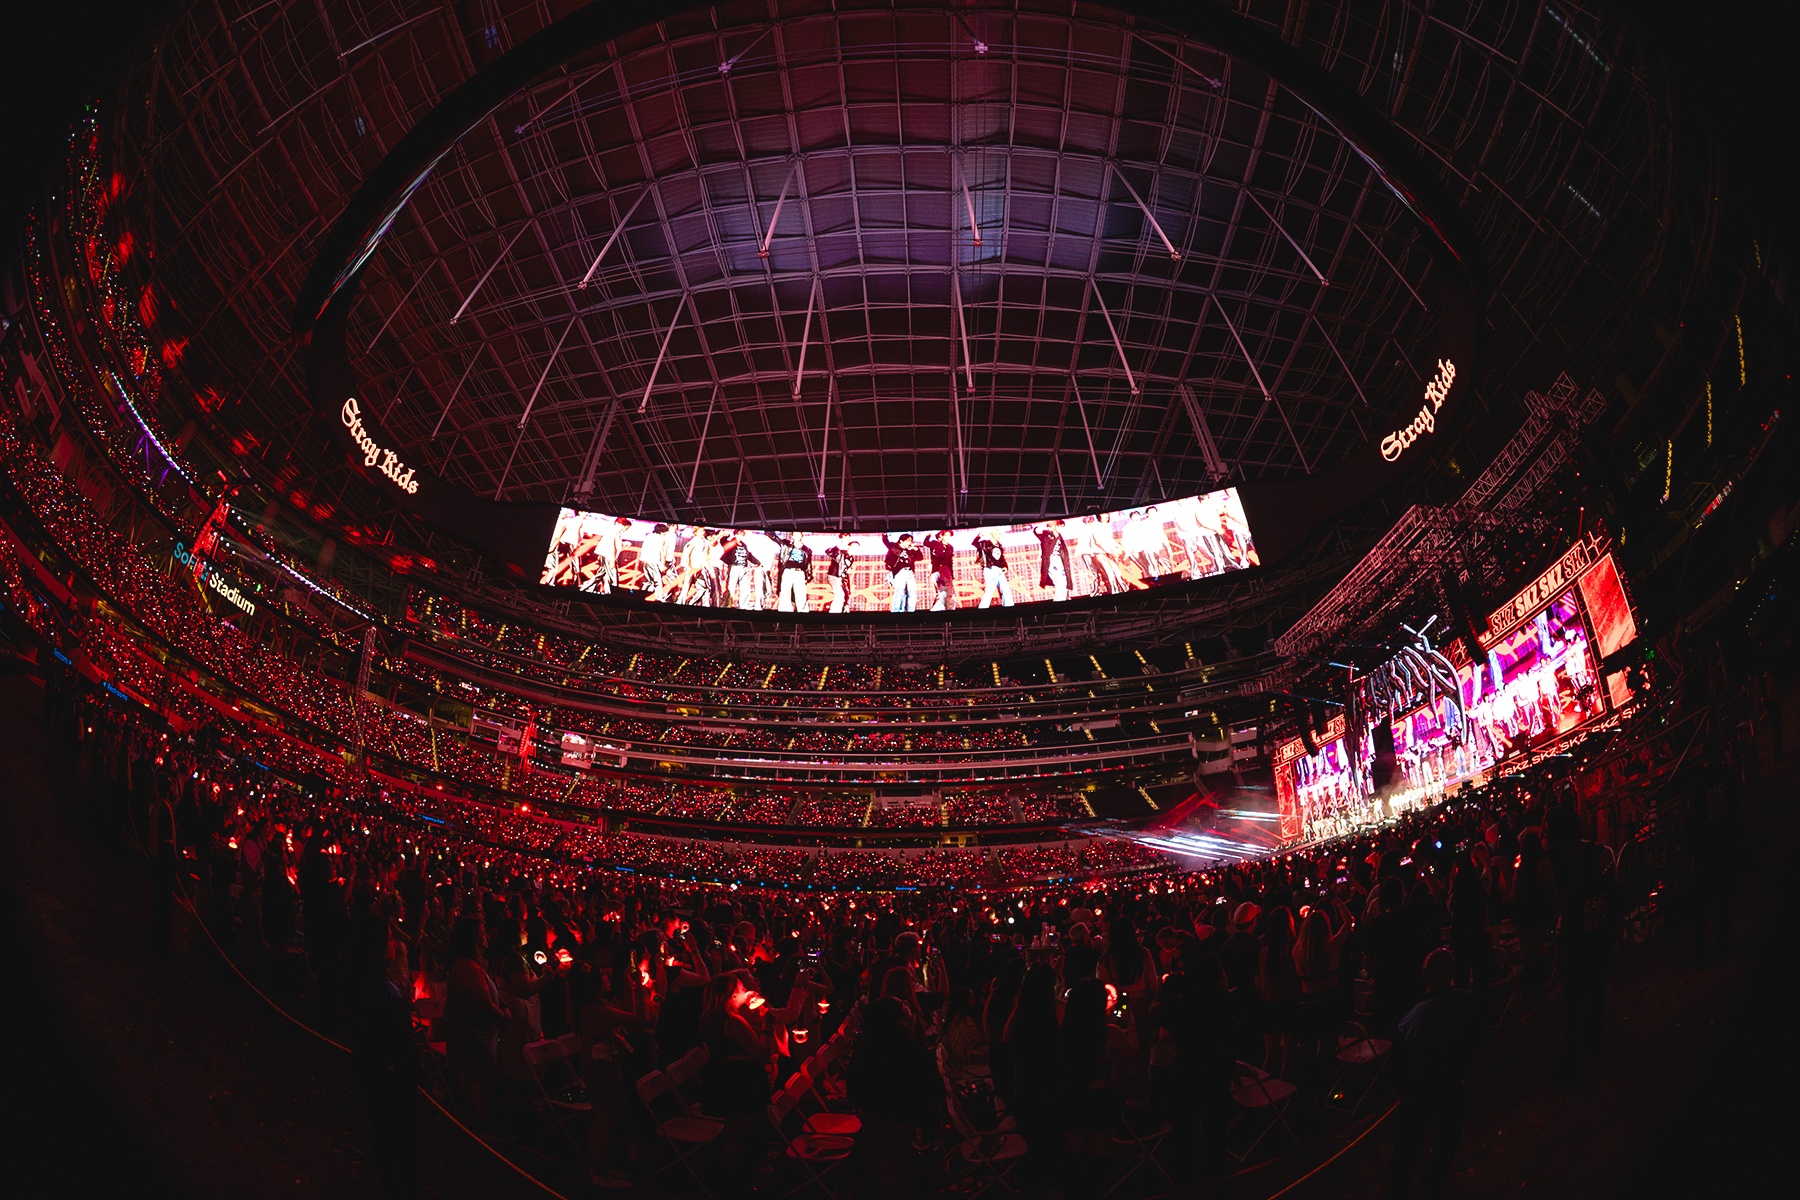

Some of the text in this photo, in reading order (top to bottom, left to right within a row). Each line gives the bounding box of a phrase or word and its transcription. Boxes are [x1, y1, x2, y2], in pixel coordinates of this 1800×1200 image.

[341, 397, 419, 494] Stray Kids
[1381, 358, 1456, 461] Stray Kids
[209, 573, 256, 616] Stadium
[1515, 587, 1540, 617] SKZ
[1539, 563, 1564, 599] SKZ
